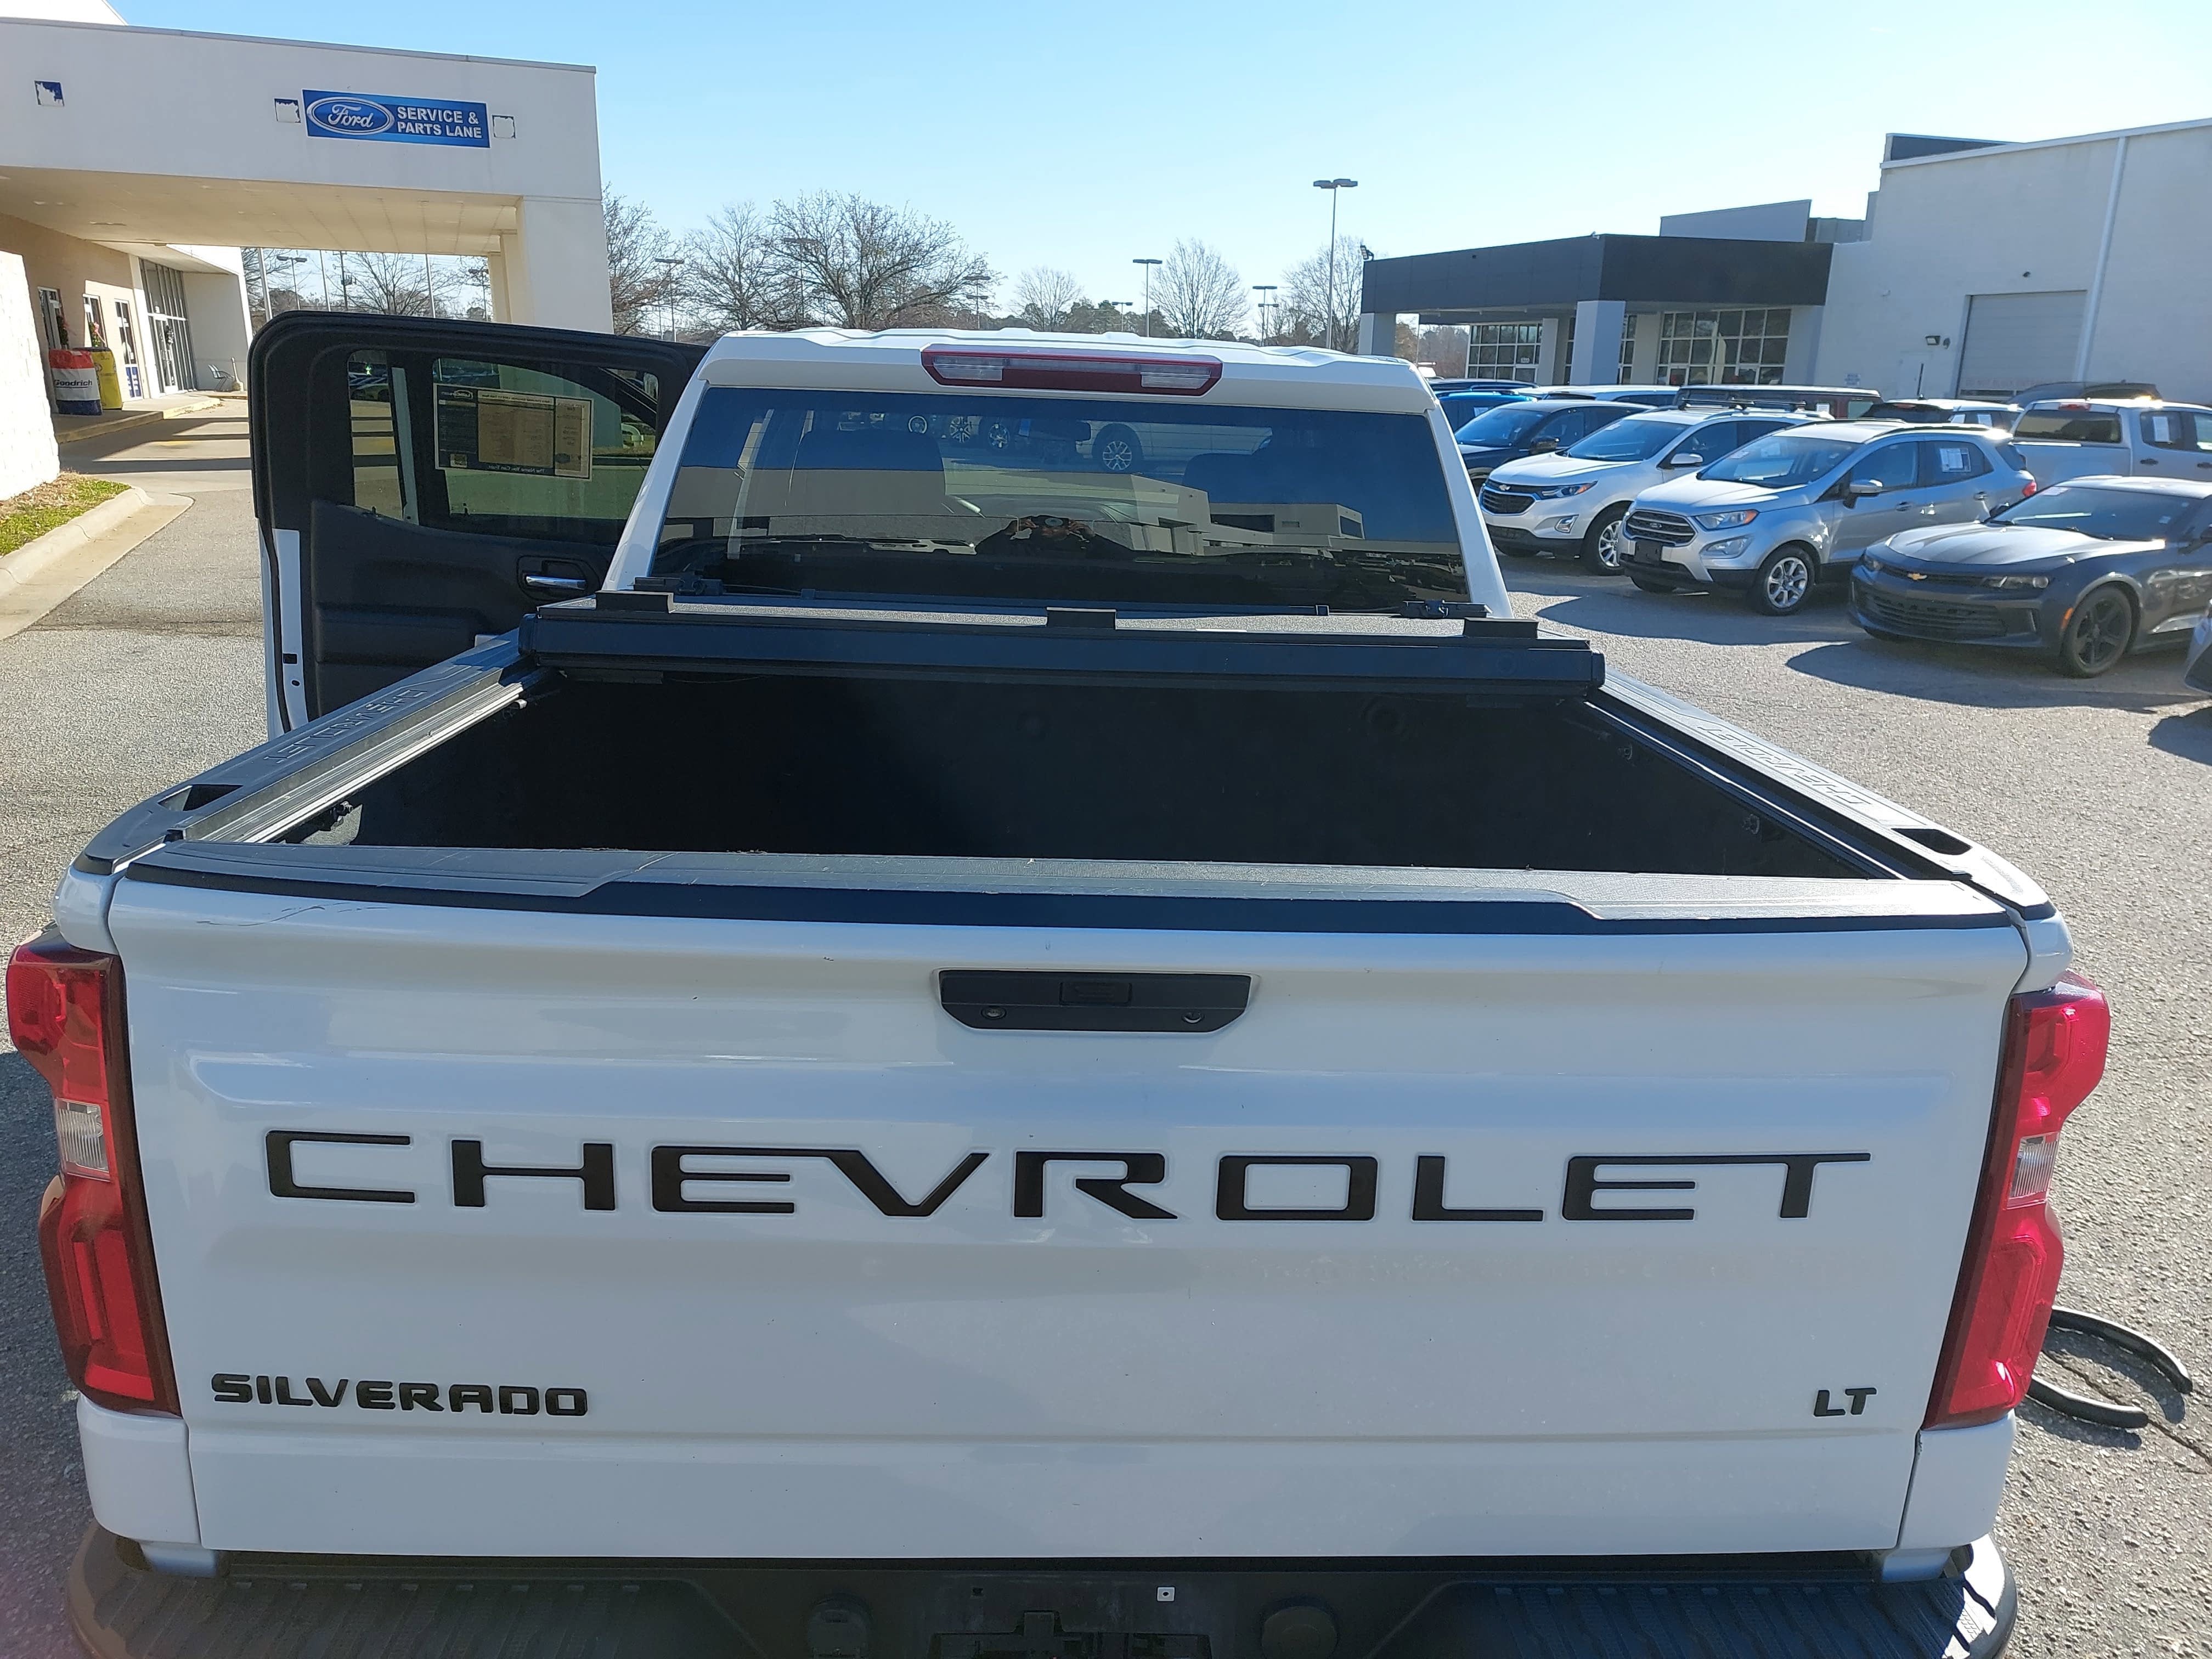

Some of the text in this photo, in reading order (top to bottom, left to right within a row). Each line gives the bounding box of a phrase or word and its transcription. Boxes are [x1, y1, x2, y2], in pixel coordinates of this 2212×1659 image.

[328, 104, 374, 128] Ford
[397, 106, 479, 124] SERVICE &
[397, 122, 483, 139] PARTS LANE
[265, 1130, 1872, 1222] CHEVROLET
[212, 1373, 588, 1417] SILVERADO
[1813, 1387, 1877, 1417] LT
